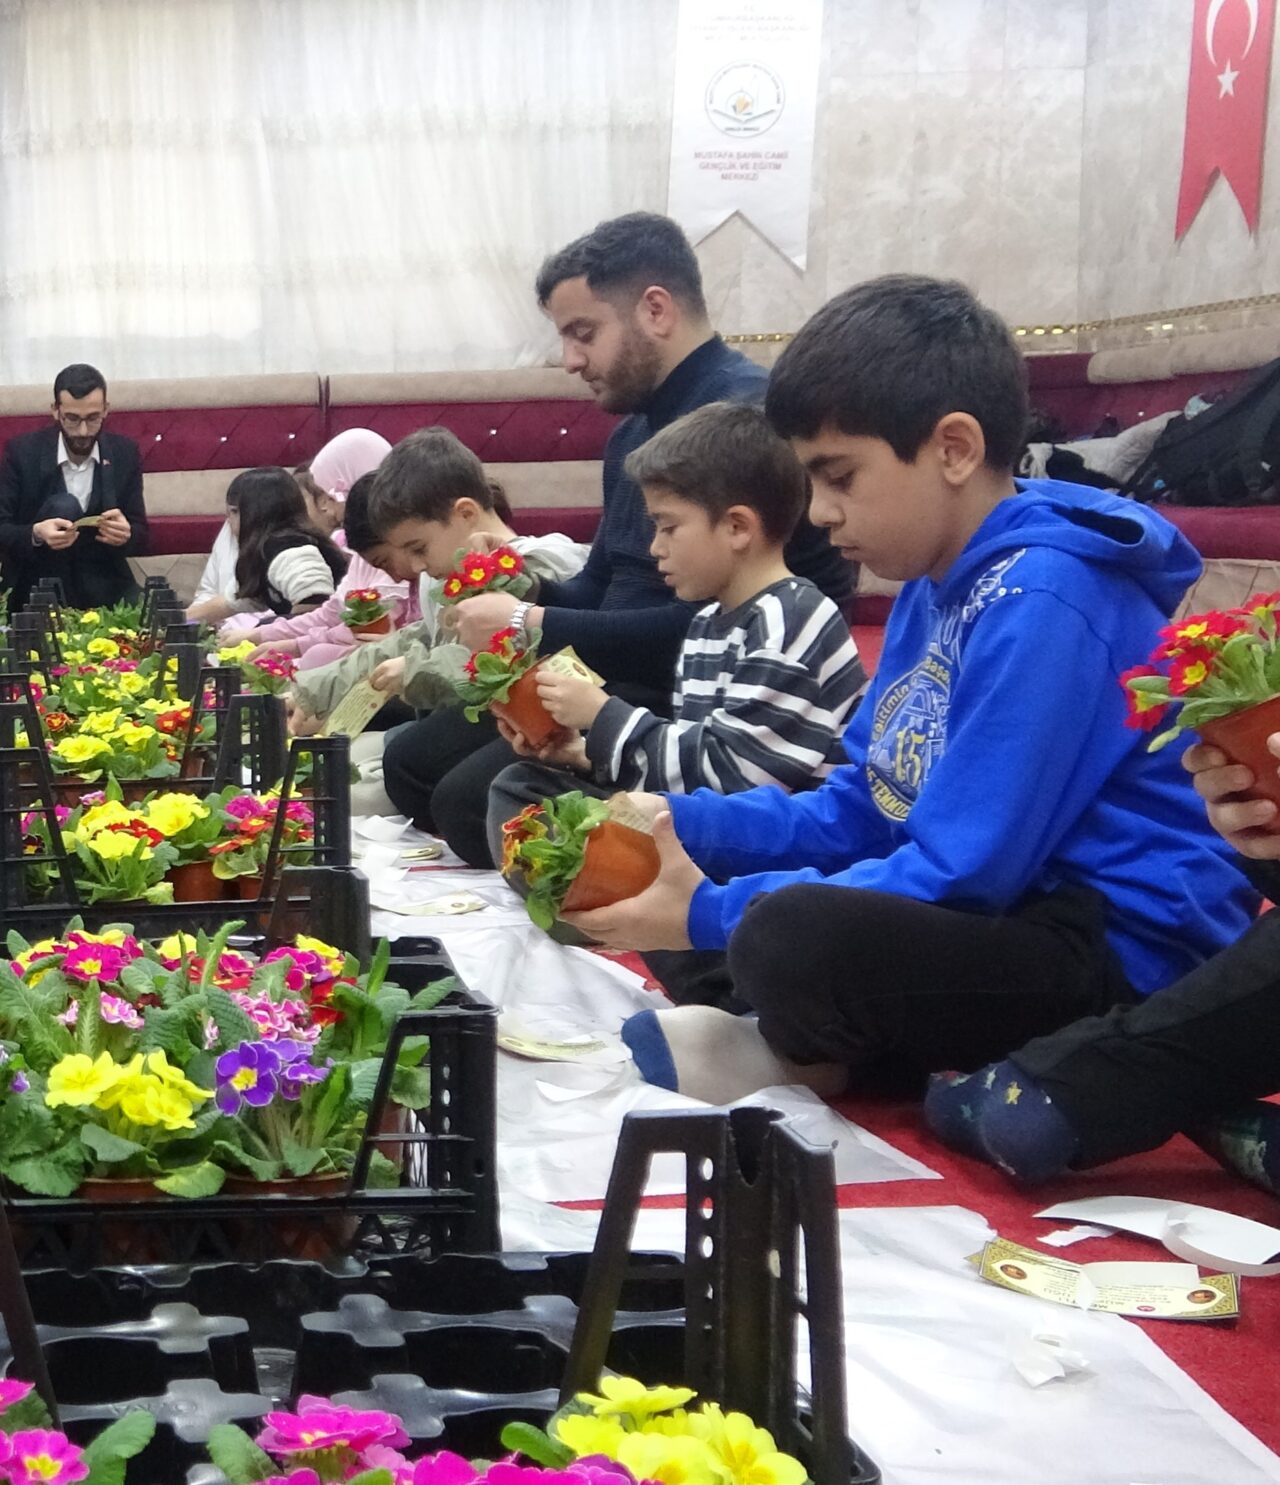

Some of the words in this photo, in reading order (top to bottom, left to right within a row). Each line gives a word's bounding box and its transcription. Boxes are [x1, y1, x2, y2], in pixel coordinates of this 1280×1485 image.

[694, 151, 733, 160] MUSTAFA
[699, 161, 736, 172] GENÇLİK
[739, 162, 750, 171] VE
[895, 726, 927, 788] 15
